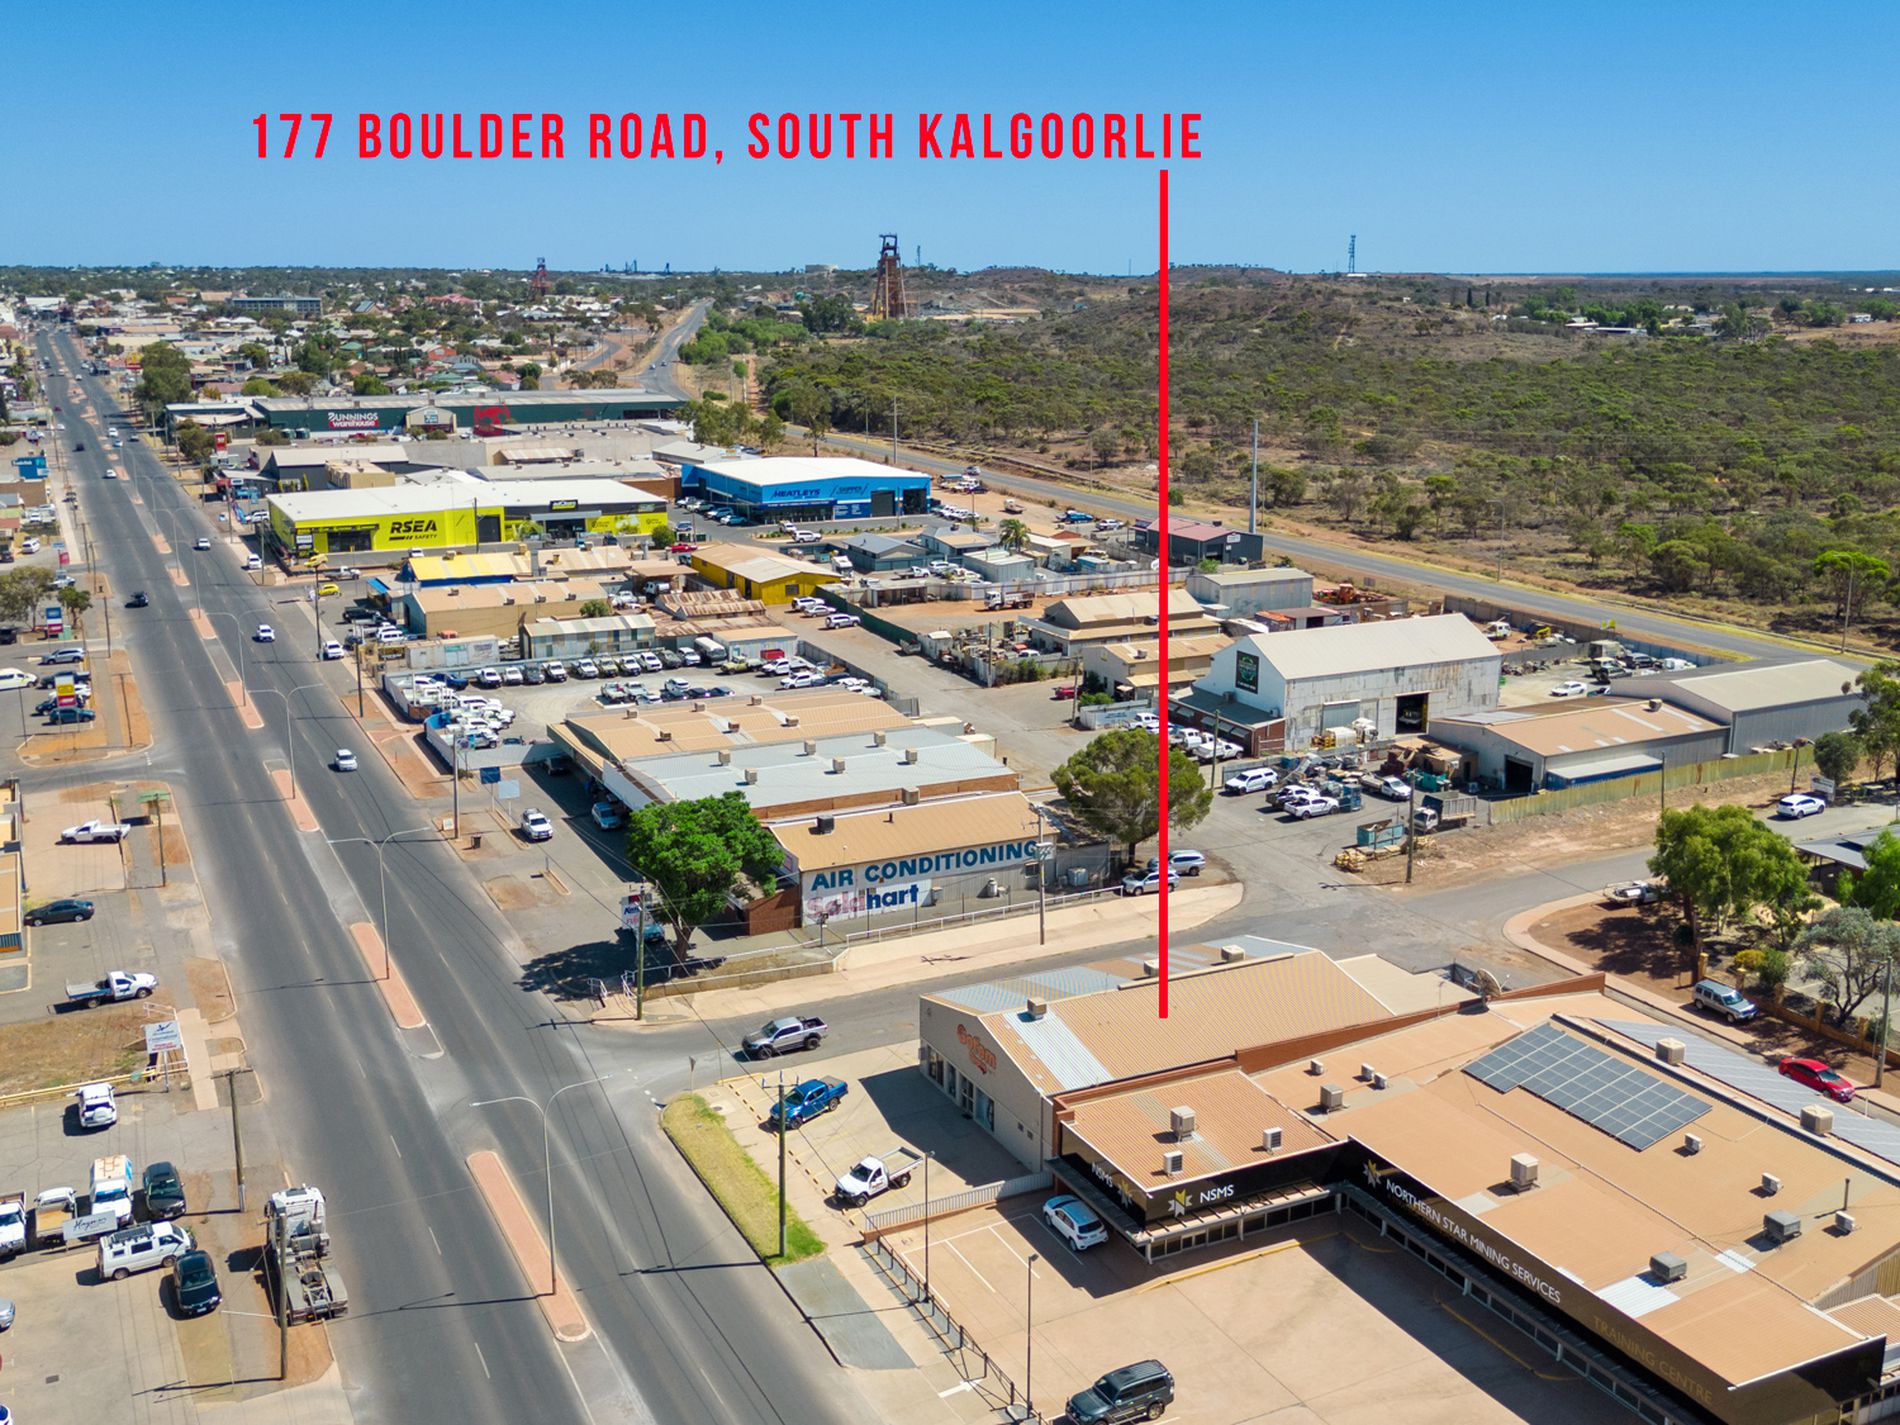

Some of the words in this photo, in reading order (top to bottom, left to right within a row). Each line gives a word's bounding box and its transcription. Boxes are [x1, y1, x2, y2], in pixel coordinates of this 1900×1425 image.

[390, 519, 437, 534] RSEA
[811, 868, 854, 891] AIR
[864, 840, 1038, 882] CONDITIONING
[1200, 1184, 1235, 1204] NSMS
[1386, 1179, 1441, 1224] NORTHERN
[1442, 1216, 1468, 1243] STAR
[1469, 1234, 1510, 1270] MINING
[1512, 1263, 1561, 1304] SERVICES
[1593, 1316, 1655, 1368] TRAINING
[1659, 1360, 1713, 1405] CENTRE
